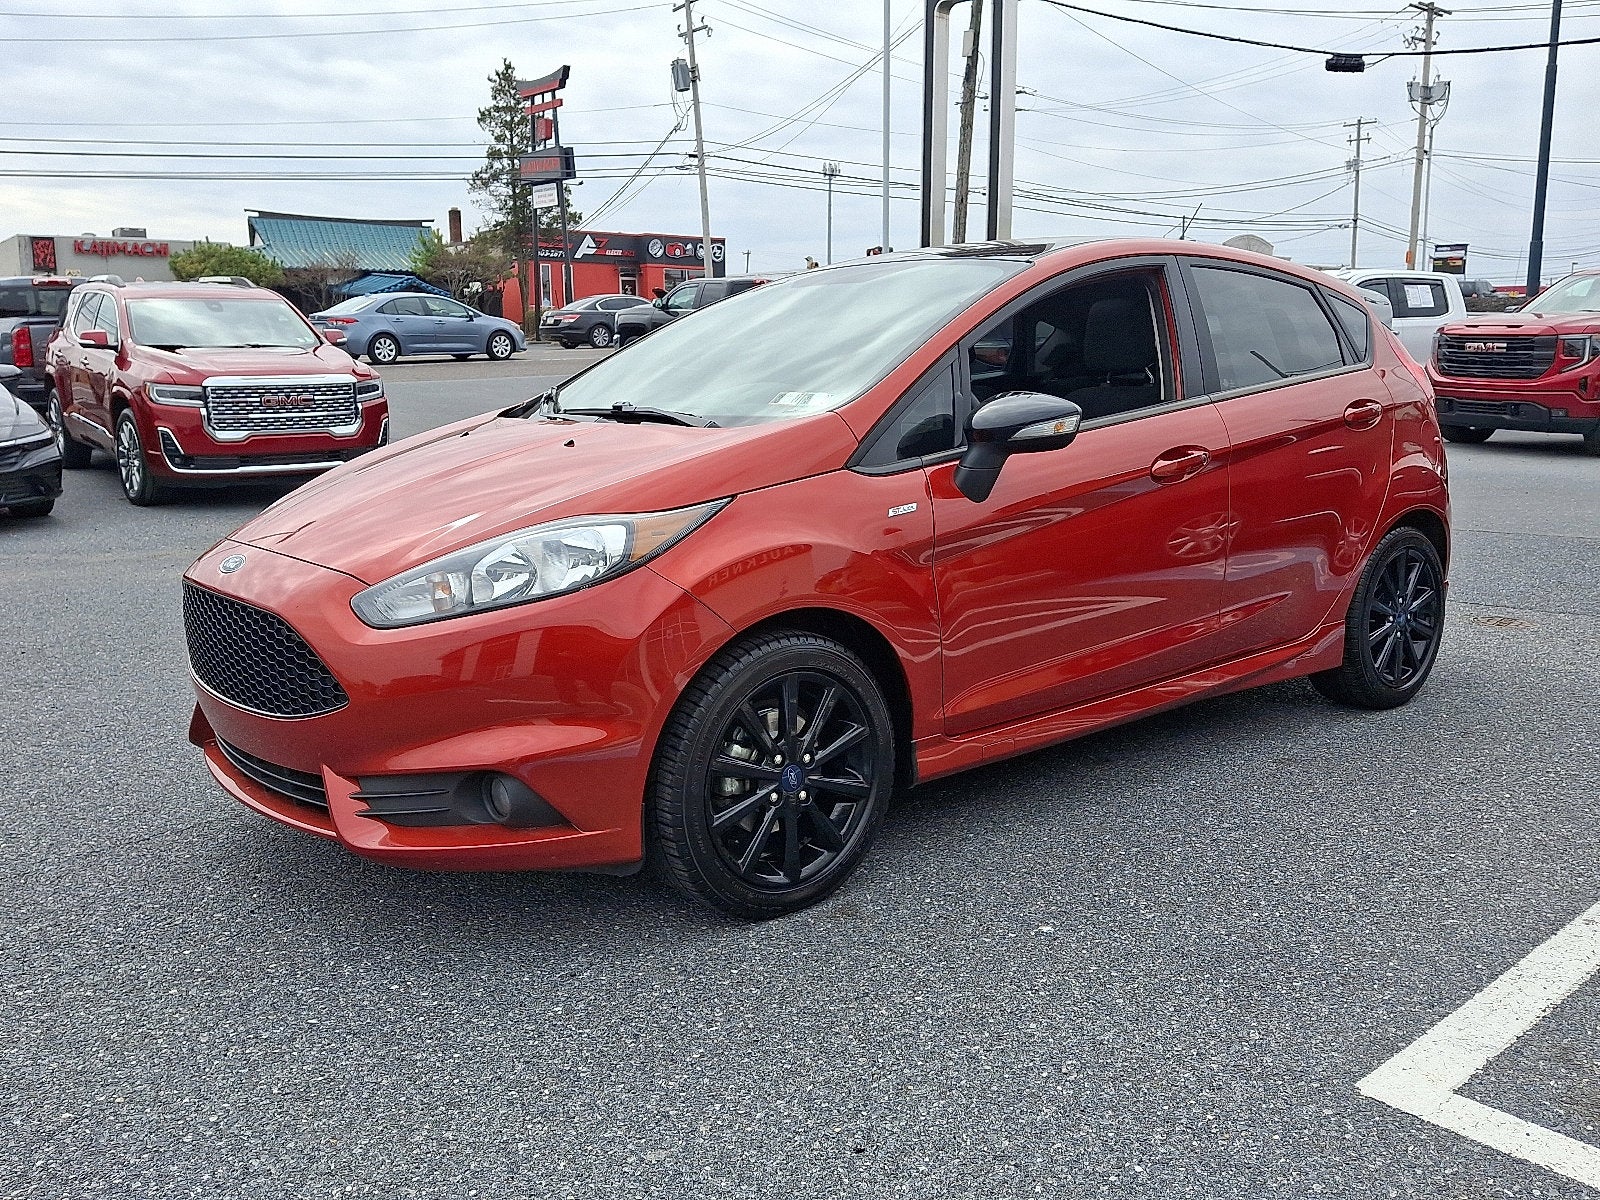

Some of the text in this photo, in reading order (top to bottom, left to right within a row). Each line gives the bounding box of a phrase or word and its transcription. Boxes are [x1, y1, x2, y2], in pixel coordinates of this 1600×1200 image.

[74, 240, 169, 257] KAJIMACHI
[1465, 342, 1507, 353] GMC
[262, 395, 314, 407] GMC
